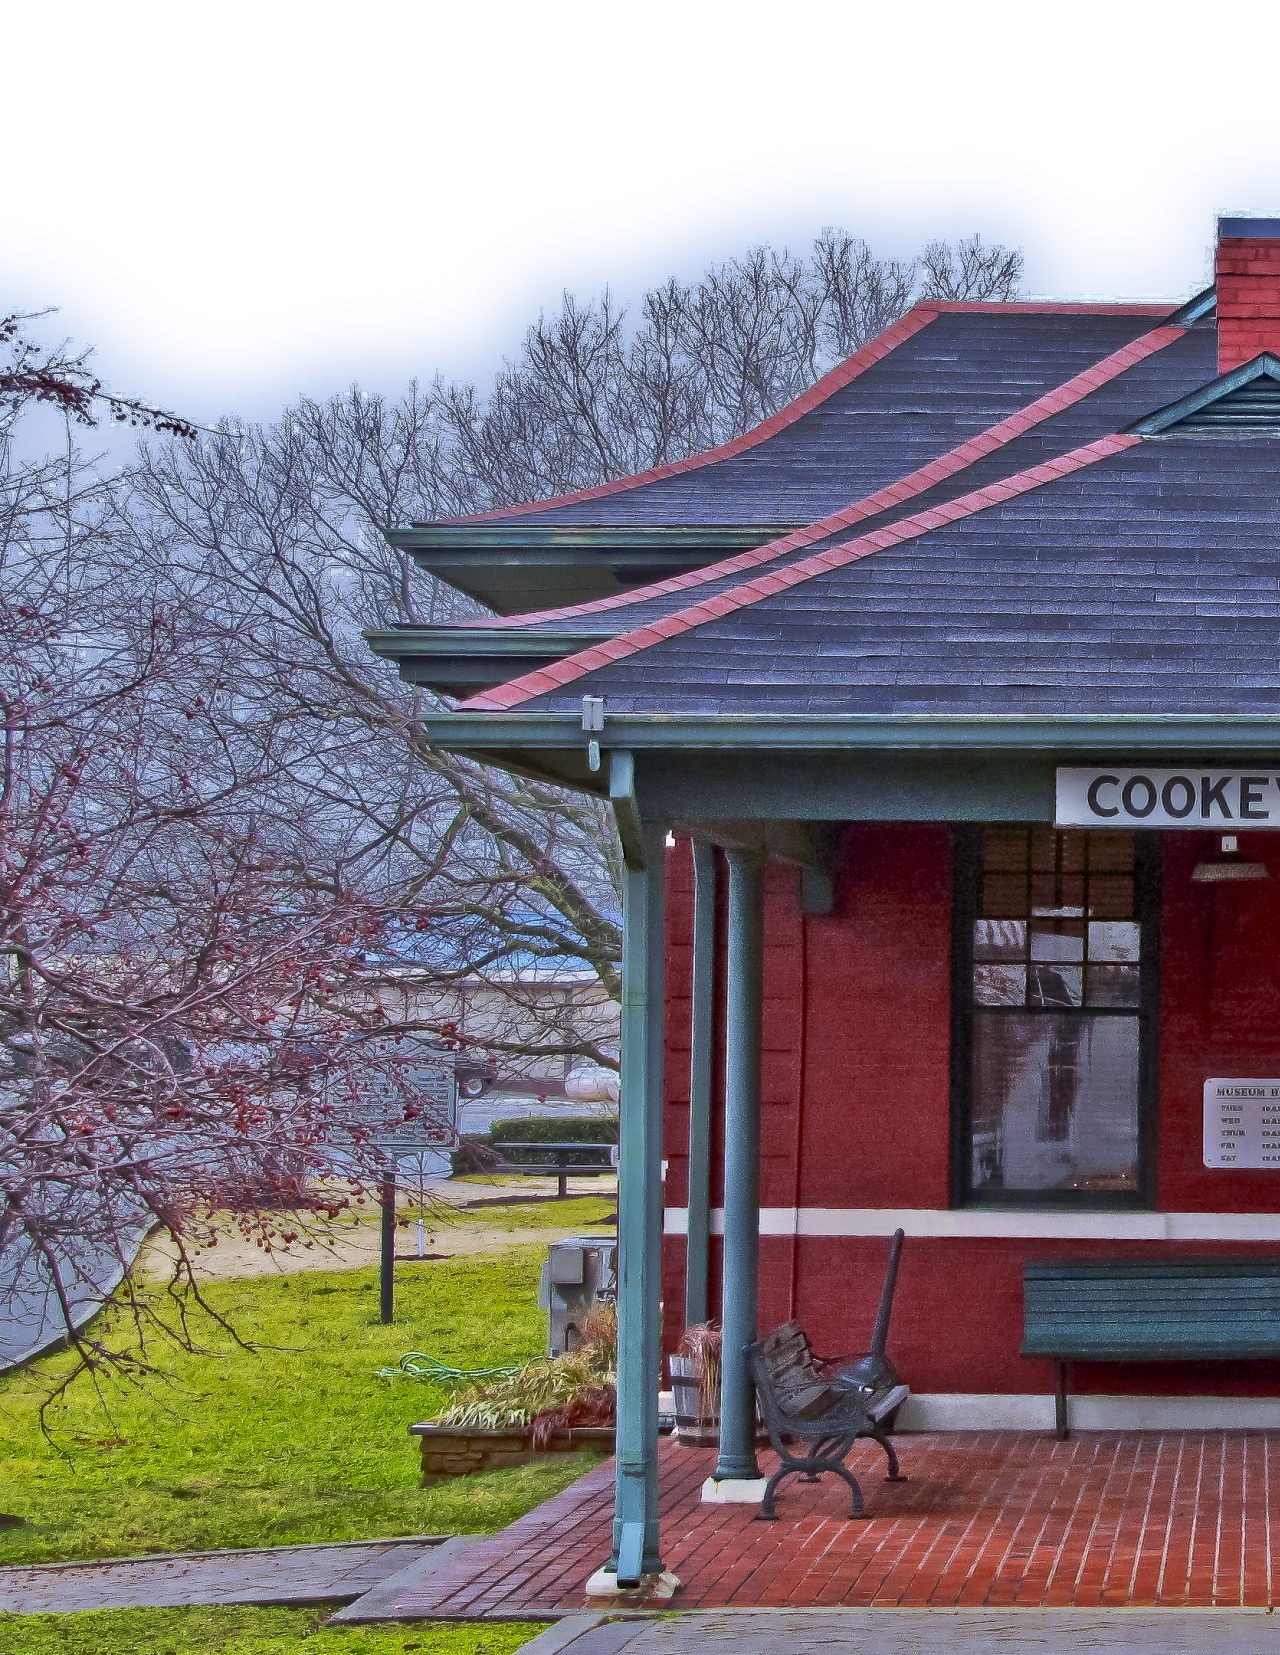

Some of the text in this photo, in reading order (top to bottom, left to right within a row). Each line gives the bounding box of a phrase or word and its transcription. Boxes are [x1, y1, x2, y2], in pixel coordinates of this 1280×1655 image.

[1216, 1087, 1265, 1097] MUSEUM
[1220, 1104, 1243, 1112] TUES
[1220, 1129, 1246, 1137] THUR
